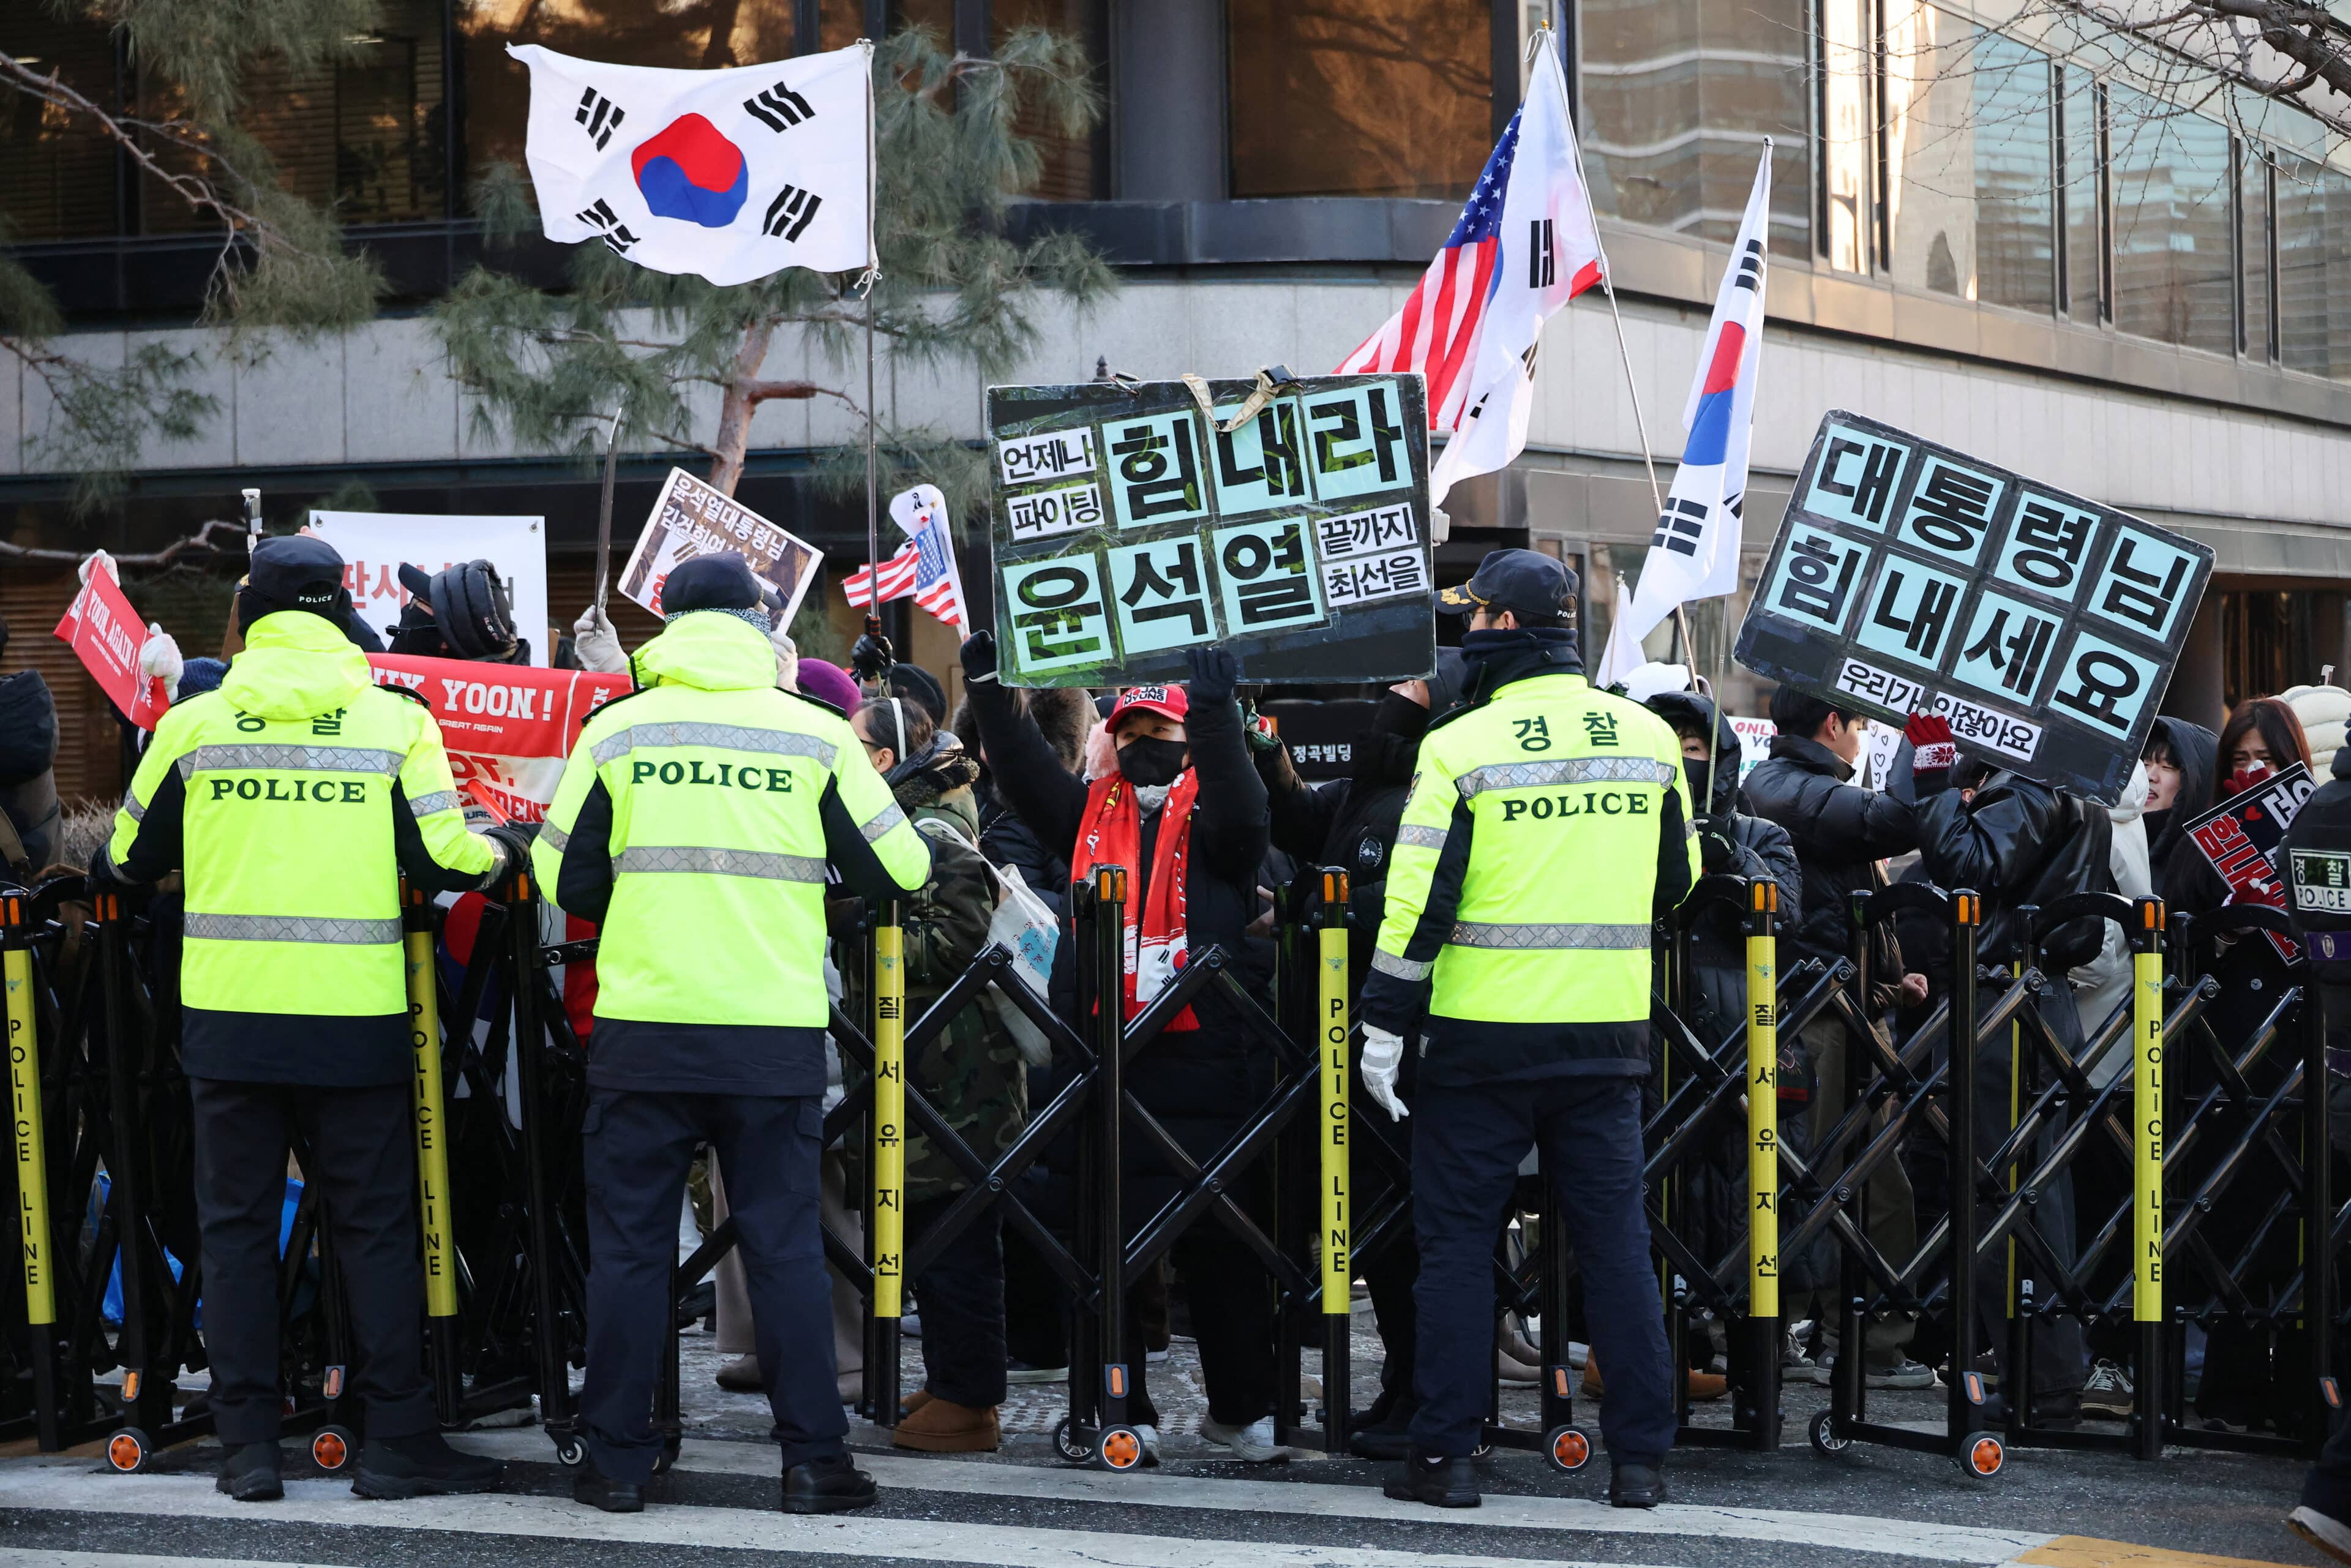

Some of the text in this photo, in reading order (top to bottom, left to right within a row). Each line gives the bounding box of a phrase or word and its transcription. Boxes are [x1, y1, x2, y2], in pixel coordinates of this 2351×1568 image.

[1003, 433, 1093, 481] 언제나
[1112, 388, 1403, 520] 힘내라
[660, 504, 757, 571] 김건희여
[673, 477, 789, 561] 윤석열대통령님
[1013, 489, 1100, 531] 파이팅
[1321, 509, 1414, 553] 끝까지
[1818, 435, 2189, 633] 대통령님
[299, 595, 332, 603] POLICE
[1014, 523, 1316, 662] 윤석열
[1327, 555, 1421, 601] 최선을
[1779, 534, 2141, 732] 힘내세요
[1842, 664, 1919, 715] 우리가
[439, 719, 504, 734] GREAT AGAIN
[1292, 743, 1351, 763] 정곡빌딩
[210, 778, 366, 803] POLICE
[631, 760, 793, 793] POLICE
[1502, 792, 1649, 822] POLICE
[10, 1019, 38, 1285] POLICE LINE
[410, 1003, 441, 1277] POLICE LINE
[877, 996, 899, 1277] 질서유지선
[1328, 999, 1346, 1273] POLICE LINE
[1755, 1003, 1777, 1278] 질서유지선
[2147, 1020, 2162, 1283] POLICE LINE
